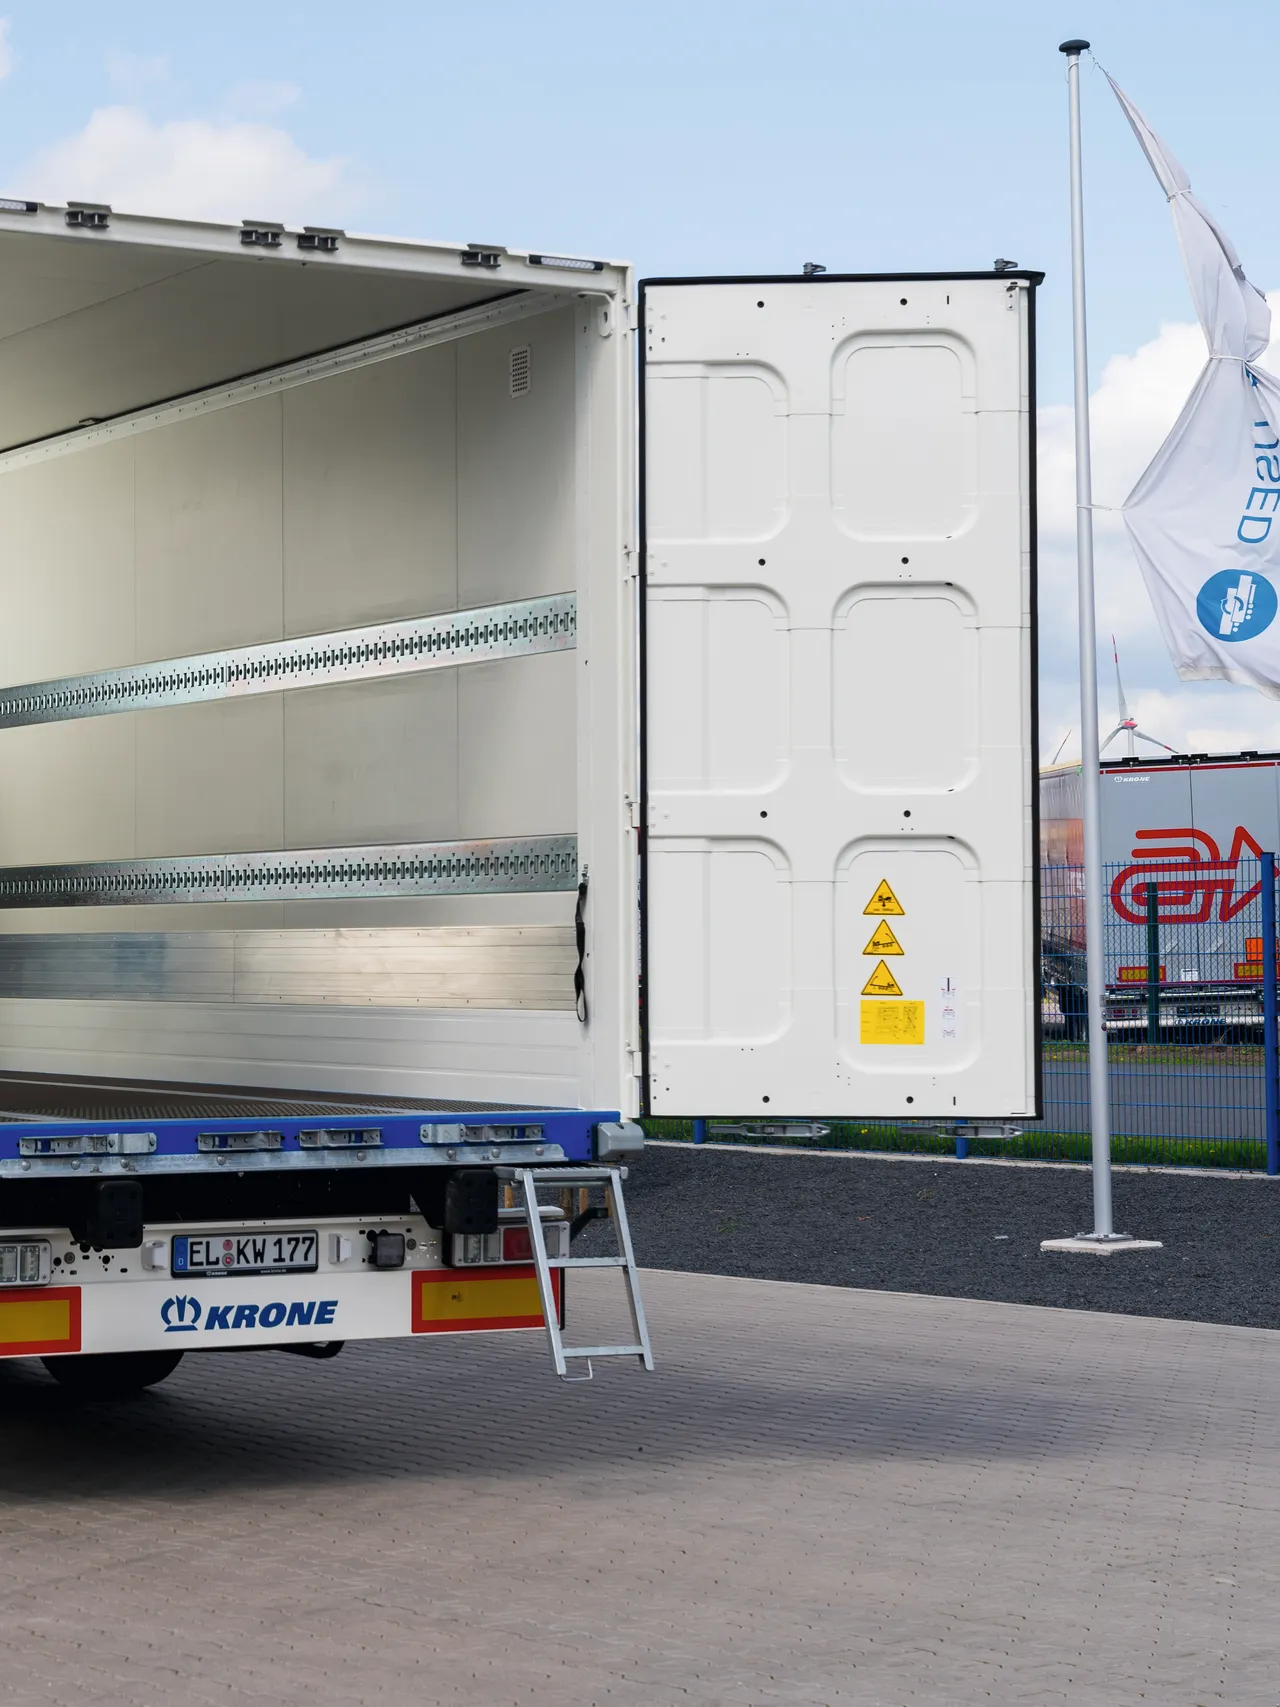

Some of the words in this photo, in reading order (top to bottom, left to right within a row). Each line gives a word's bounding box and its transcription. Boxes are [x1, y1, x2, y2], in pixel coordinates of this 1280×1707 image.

[189, 1240, 219, 1266] EL
[236, 1238, 266, 1264] KW
[272, 1236, 315, 1263] 177
[204, 1300, 339, 1330] KRONE
